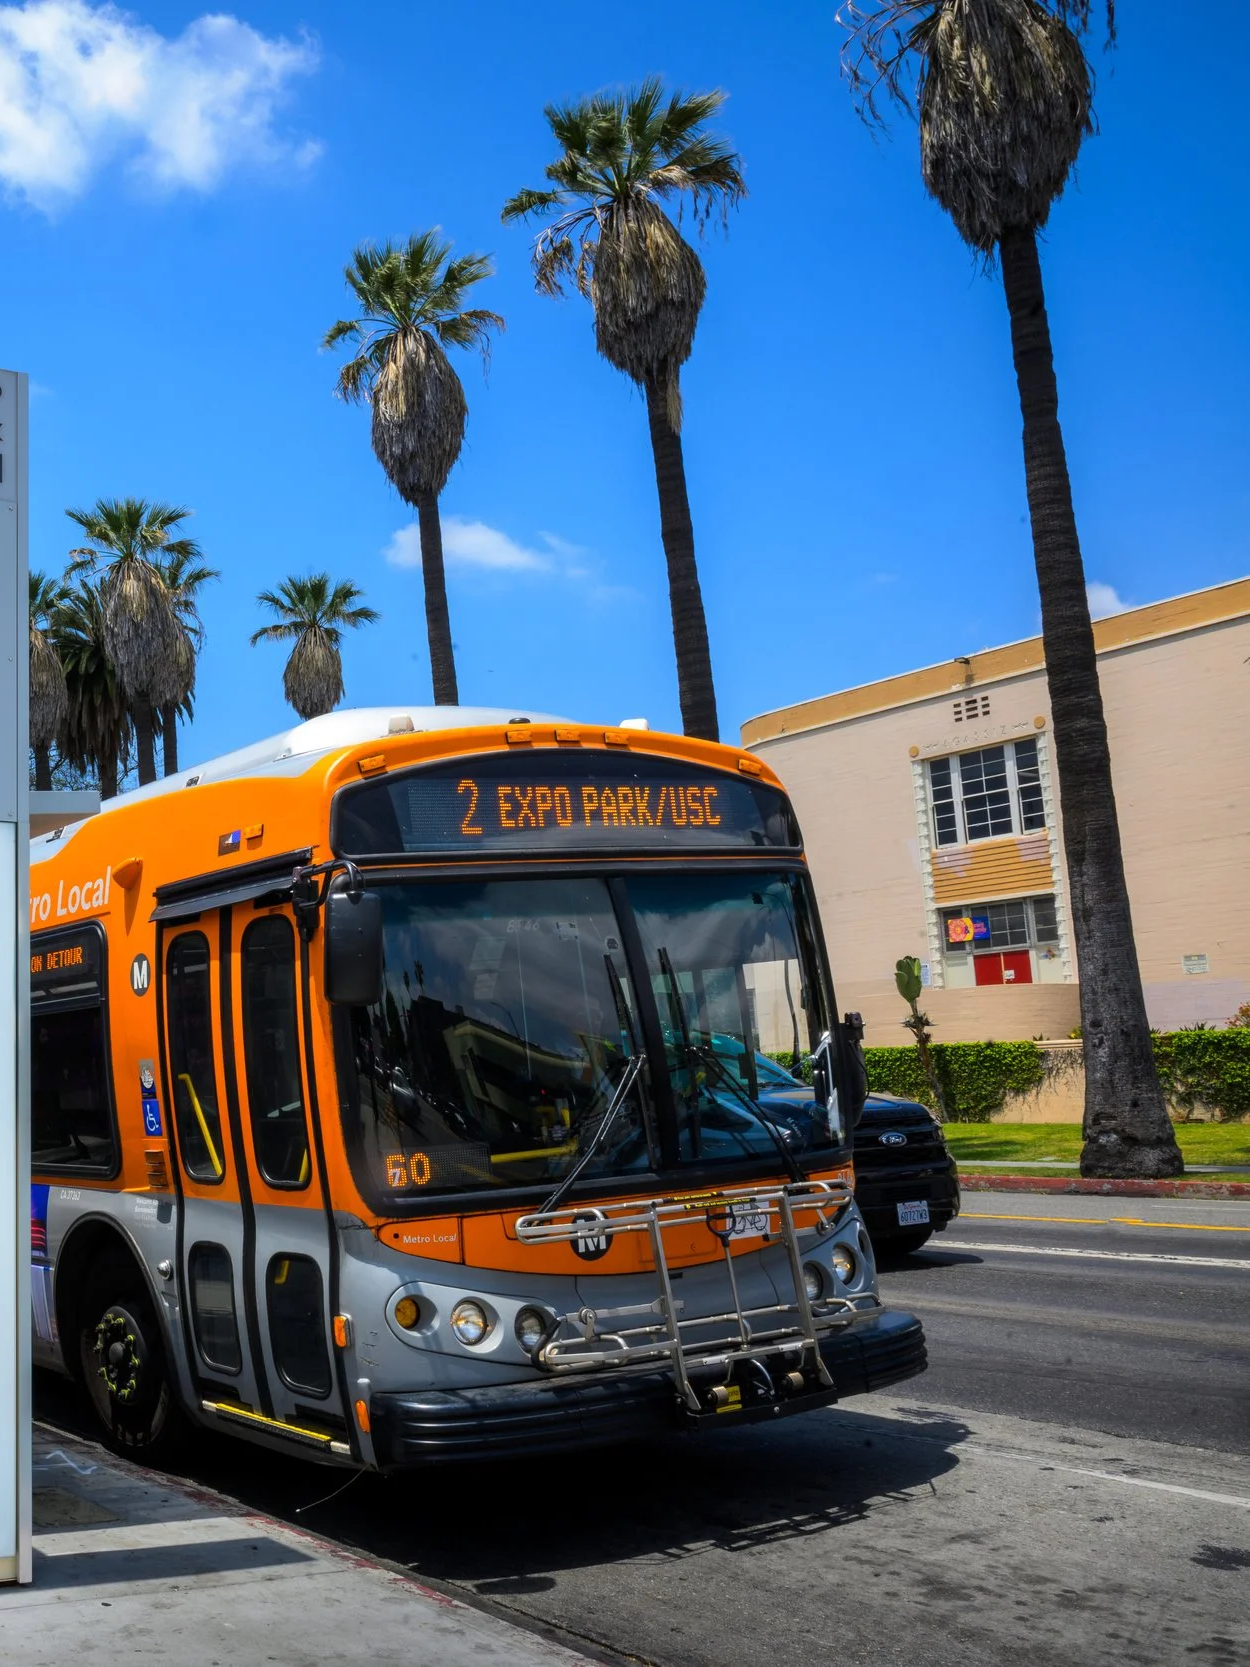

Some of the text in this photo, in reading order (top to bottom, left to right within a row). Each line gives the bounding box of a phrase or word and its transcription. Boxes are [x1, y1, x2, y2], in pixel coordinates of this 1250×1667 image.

[456, 778, 722, 835] 2 EXPO PARK/USC
[56, 865, 112, 917] Local
[46, 946, 83, 970] DETOUR
[133, 960, 148, 990] M
[386, 1152, 431, 1187] 60
[403, 1233, 457, 1244] Metro Local
